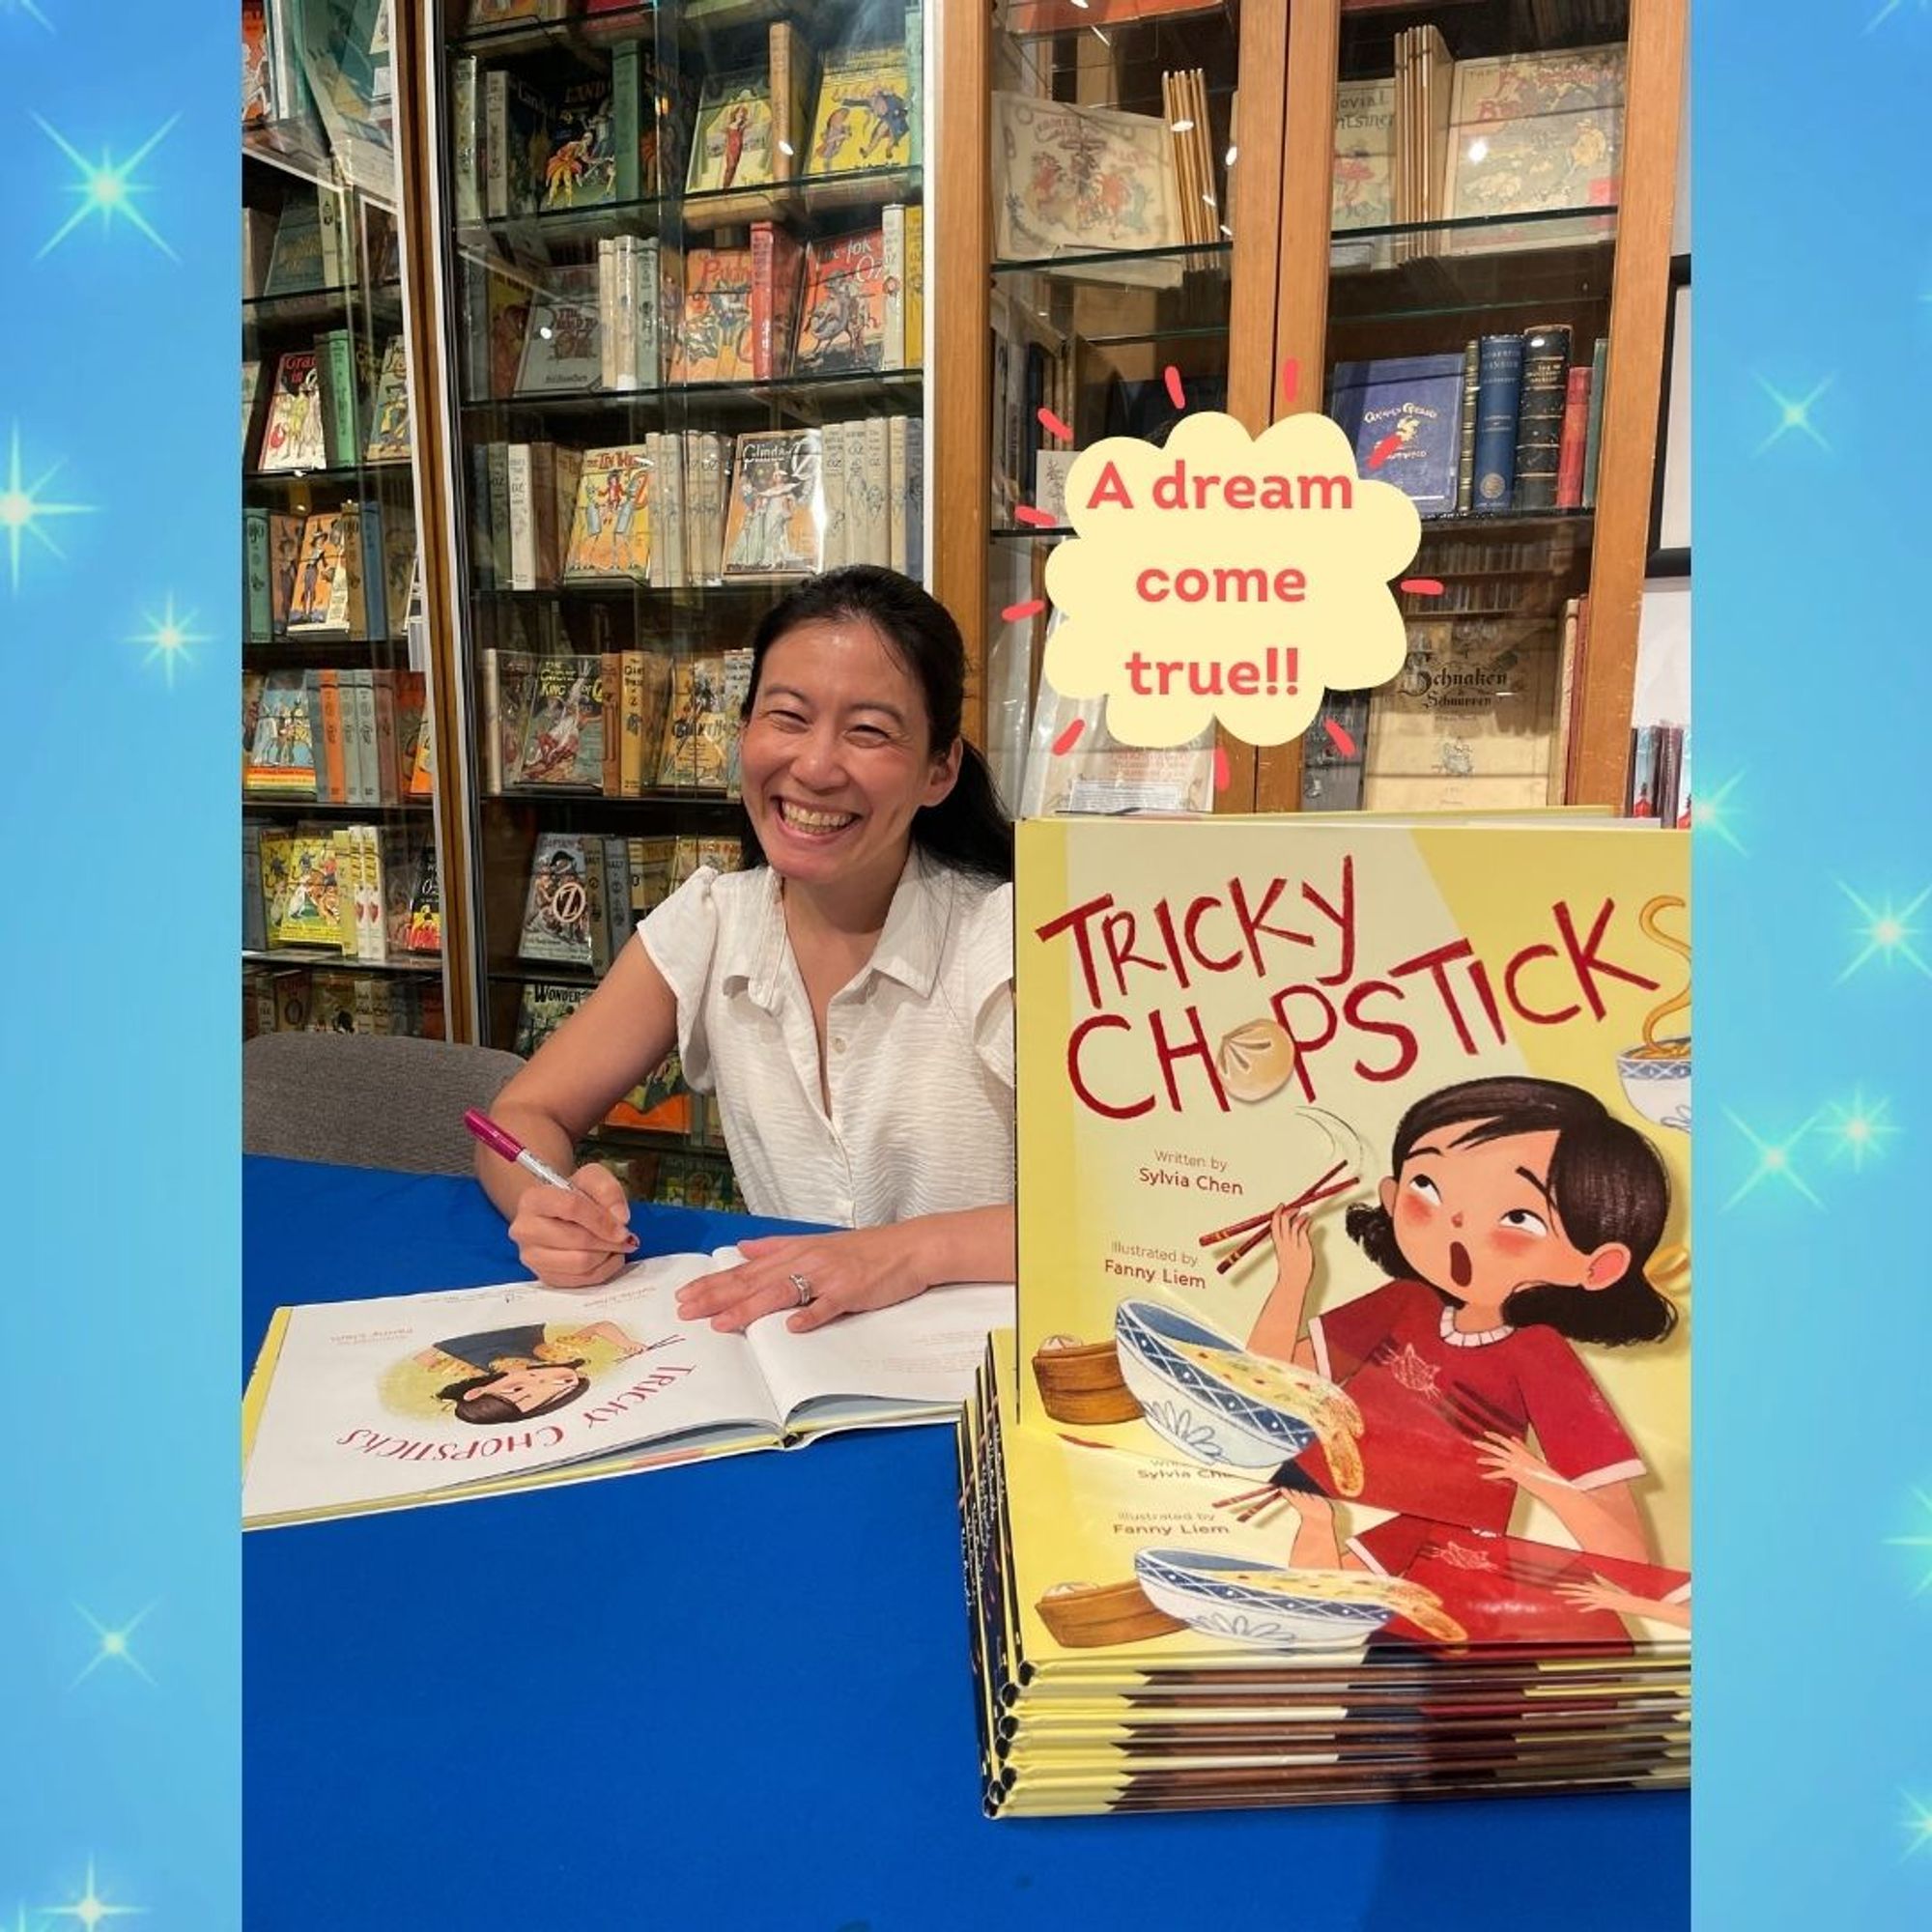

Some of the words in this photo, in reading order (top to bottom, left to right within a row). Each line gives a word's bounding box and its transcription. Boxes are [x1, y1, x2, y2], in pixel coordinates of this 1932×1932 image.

[1035, 854, 1354, 1009] TRICKY
[1154, 1149, 1207, 1168] Written
[1210, 1155, 1228, 1173] by
[1139, 1167, 1190, 1186] Sylvia
[1196, 1175, 1243, 1196] Chen
[1111, 1240, 1178, 1264] Illustrated
[1181, 1253, 1199, 1268] by
[1104, 1259, 1156, 1284] Fanny
[1162, 1268, 1207, 1290] Liem
[582, 1361, 697, 1430] TRICKY
[337, 1424, 564, 1462] CHOPSTICKS
[1136, 1468, 1191, 1480] Sylvia
[1113, 1523, 1172, 1536] Fanny
[1180, 1523, 1230, 1535] Liem
